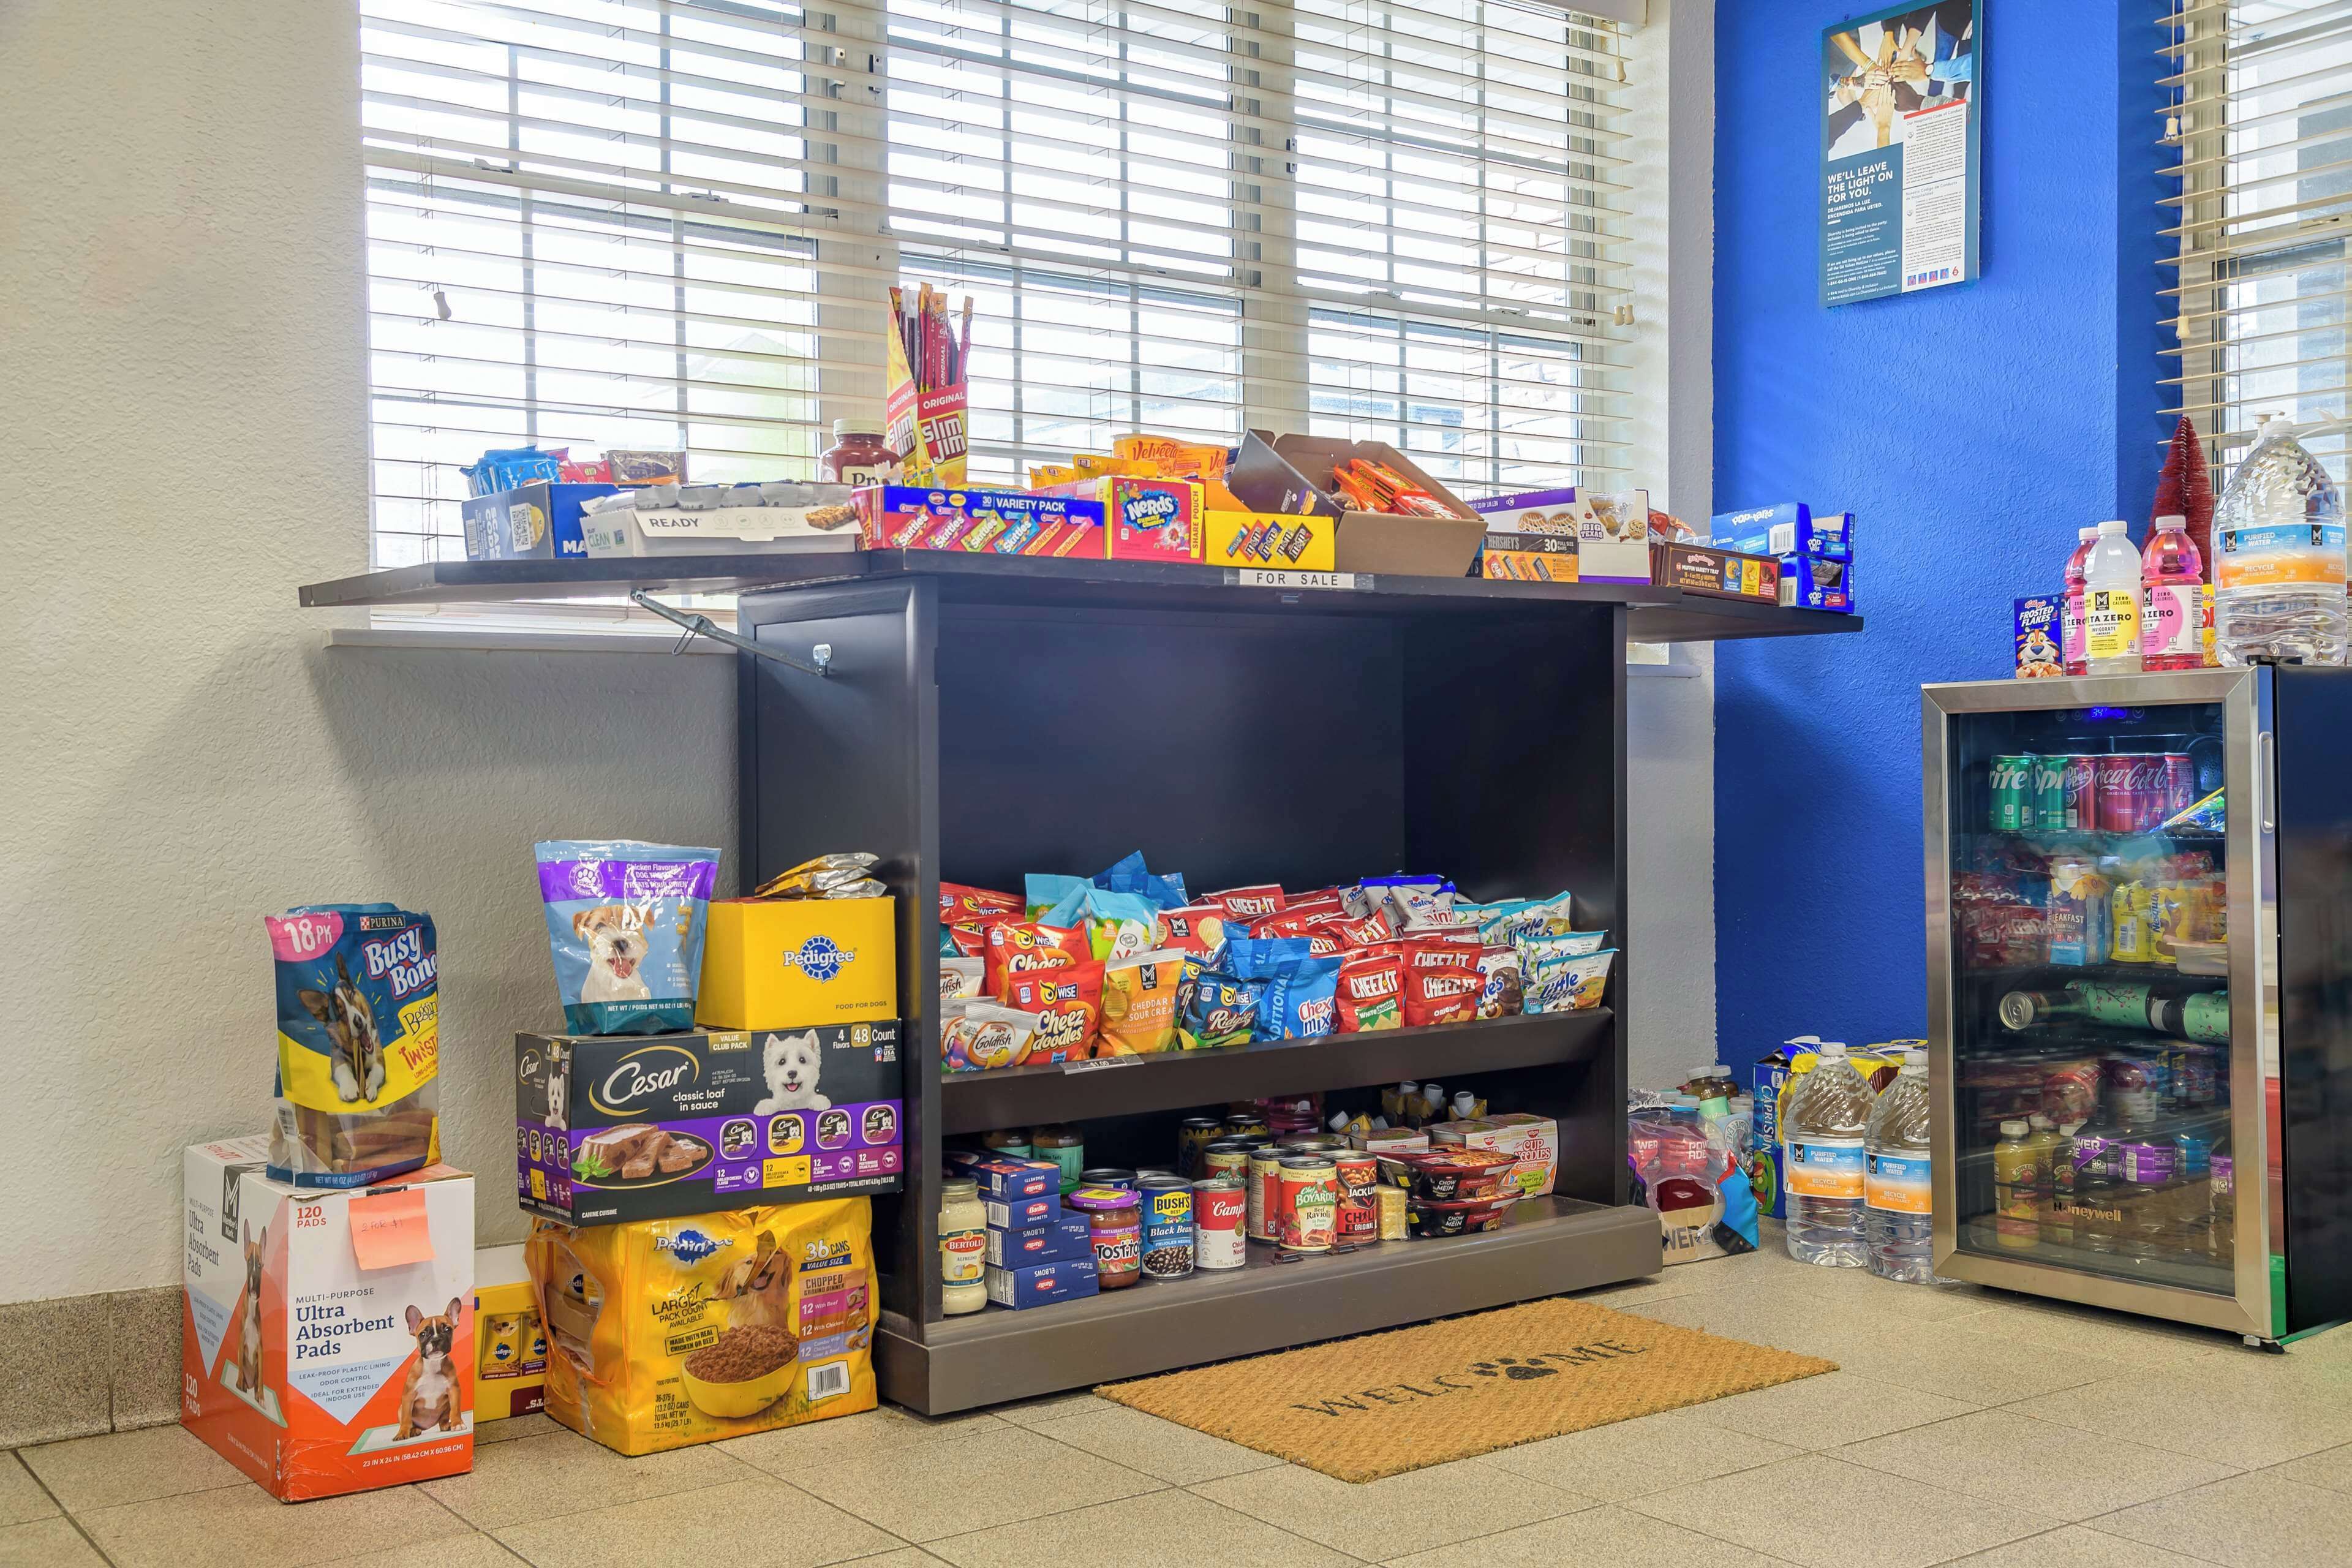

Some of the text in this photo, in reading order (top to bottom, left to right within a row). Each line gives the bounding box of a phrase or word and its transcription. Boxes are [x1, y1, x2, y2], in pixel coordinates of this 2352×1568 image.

[1828, 162, 1887, 184] WE'LL LEAVE
[1828, 170, 1893, 194] THE LIGHT ON
[1828, 187, 1871, 204] FOR YOU.
[1828, 203, 1854, 213] DEJAREMOS
[1828, 210, 1853, 219] ENCENDIDA
[889, 386, 916, 413] ORIGINAL
[922, 391, 965, 410] ORIGINAL
[1133, 440, 1178, 460] Velveeta
[982, 496, 992, 505] 30
[996, 496, 1036, 510] VARIETY
[1039, 499, 1066, 512] PACK
[649, 518, 699, 528] READY
[1581, 523, 1602, 532] BIG
[588, 532, 611, 546] CLEAN
[1580, 530, 1604, 539] TEXAS
[1487, 535, 1520, 550] HERSHEY'S
[1544, 538, 1557, 552] 30
[1257, 573, 1338, 586] FOR SALE
[2019, 606, 2054, 620] FROSTED
[2021, 614, 2051, 627] FLAKES
[2149, 891, 2161, 933] Nesquik
[371, 917, 404, 928] PURINA
[284, 919, 315, 953] 18
[364, 928, 421, 975] Busy
[783, 948, 855, 967] Pedigree
[390, 955, 437, 995] Bone
[1057, 986, 1077, 998] WISE
[1131, 996, 1168, 1011] CHEDDAR
[1298, 997, 1333, 1018] Chex
[1033, 1008, 1087, 1035] Cheez
[1129, 1011, 1150, 1022] SOUR
[1303, 1012, 1331, 1036] mix
[854, 1028, 895, 1042] 48 Count
[975, 1034, 1011, 1050] Goldfish
[1031, 1026, 1085, 1052] doodles
[713, 1042, 728, 1051] CLUB
[833, 1041, 850, 1049] Flavors
[602, 1060, 688, 1106] Cesar
[673, 1088, 725, 1102] classic loaf
[690, 1101, 718, 1110] sauce
[1523, 1139, 1544, 1150] CUP
[1514, 1148, 1551, 1162] NOODLES
[717, 1169, 725, 1177] 12
[1156, 1196, 1190, 1211] BUSH'S
[1295, 1192, 1336, 1205] BOYARDEE
[296, 1205, 322, 1219] 120
[582, 1210, 598, 1218] CANINE
[1029, 1205, 1047, 1213] Barilla
[1306, 1210, 1330, 1220] Ravioli
[2054, 1202, 2121, 1222] Honeywell
[189, 1210, 203, 1235] Ultra
[297, 1218, 326, 1229] PADS
[1023, 1228, 1044, 1237] ELBOWS
[1150, 1227, 1176, 1237] Black
[189, 1232, 219, 1267] Absorbent
[805, 1239, 850, 1261] 36 CANS
[949, 1238, 983, 1250] BERTOLLI
[188, 1254, 202, 1277] Pads
[807, 1260, 827, 1270] VALUE
[806, 1274, 843, 1289] CHOPPED
[826, 1283, 844, 1292] DINNER
[296, 1287, 375, 1304] MULTI-PURPOSE
[296, 1305, 345, 1322] Ultra
[802, 1303, 813, 1314] 12
[659, 1312, 680, 1323] PACK
[296, 1315, 394, 1341] Absorbent
[802, 1324, 812, 1336] 12
[669, 1330, 713, 1346] MADE WITH REAL
[296, 1340, 341, 1359] Pads
[670, 1343, 694, 1352] CHICKEN
[299, 1369, 340, 1379] LEAK-PROOF
[342, 1365, 368, 1373] PLASTIC
[341, 1374, 371, 1383] CONTROL
[347, 1383, 380, 1393] EXTENDED
[654, 1412, 668, 1421] TOTAL
